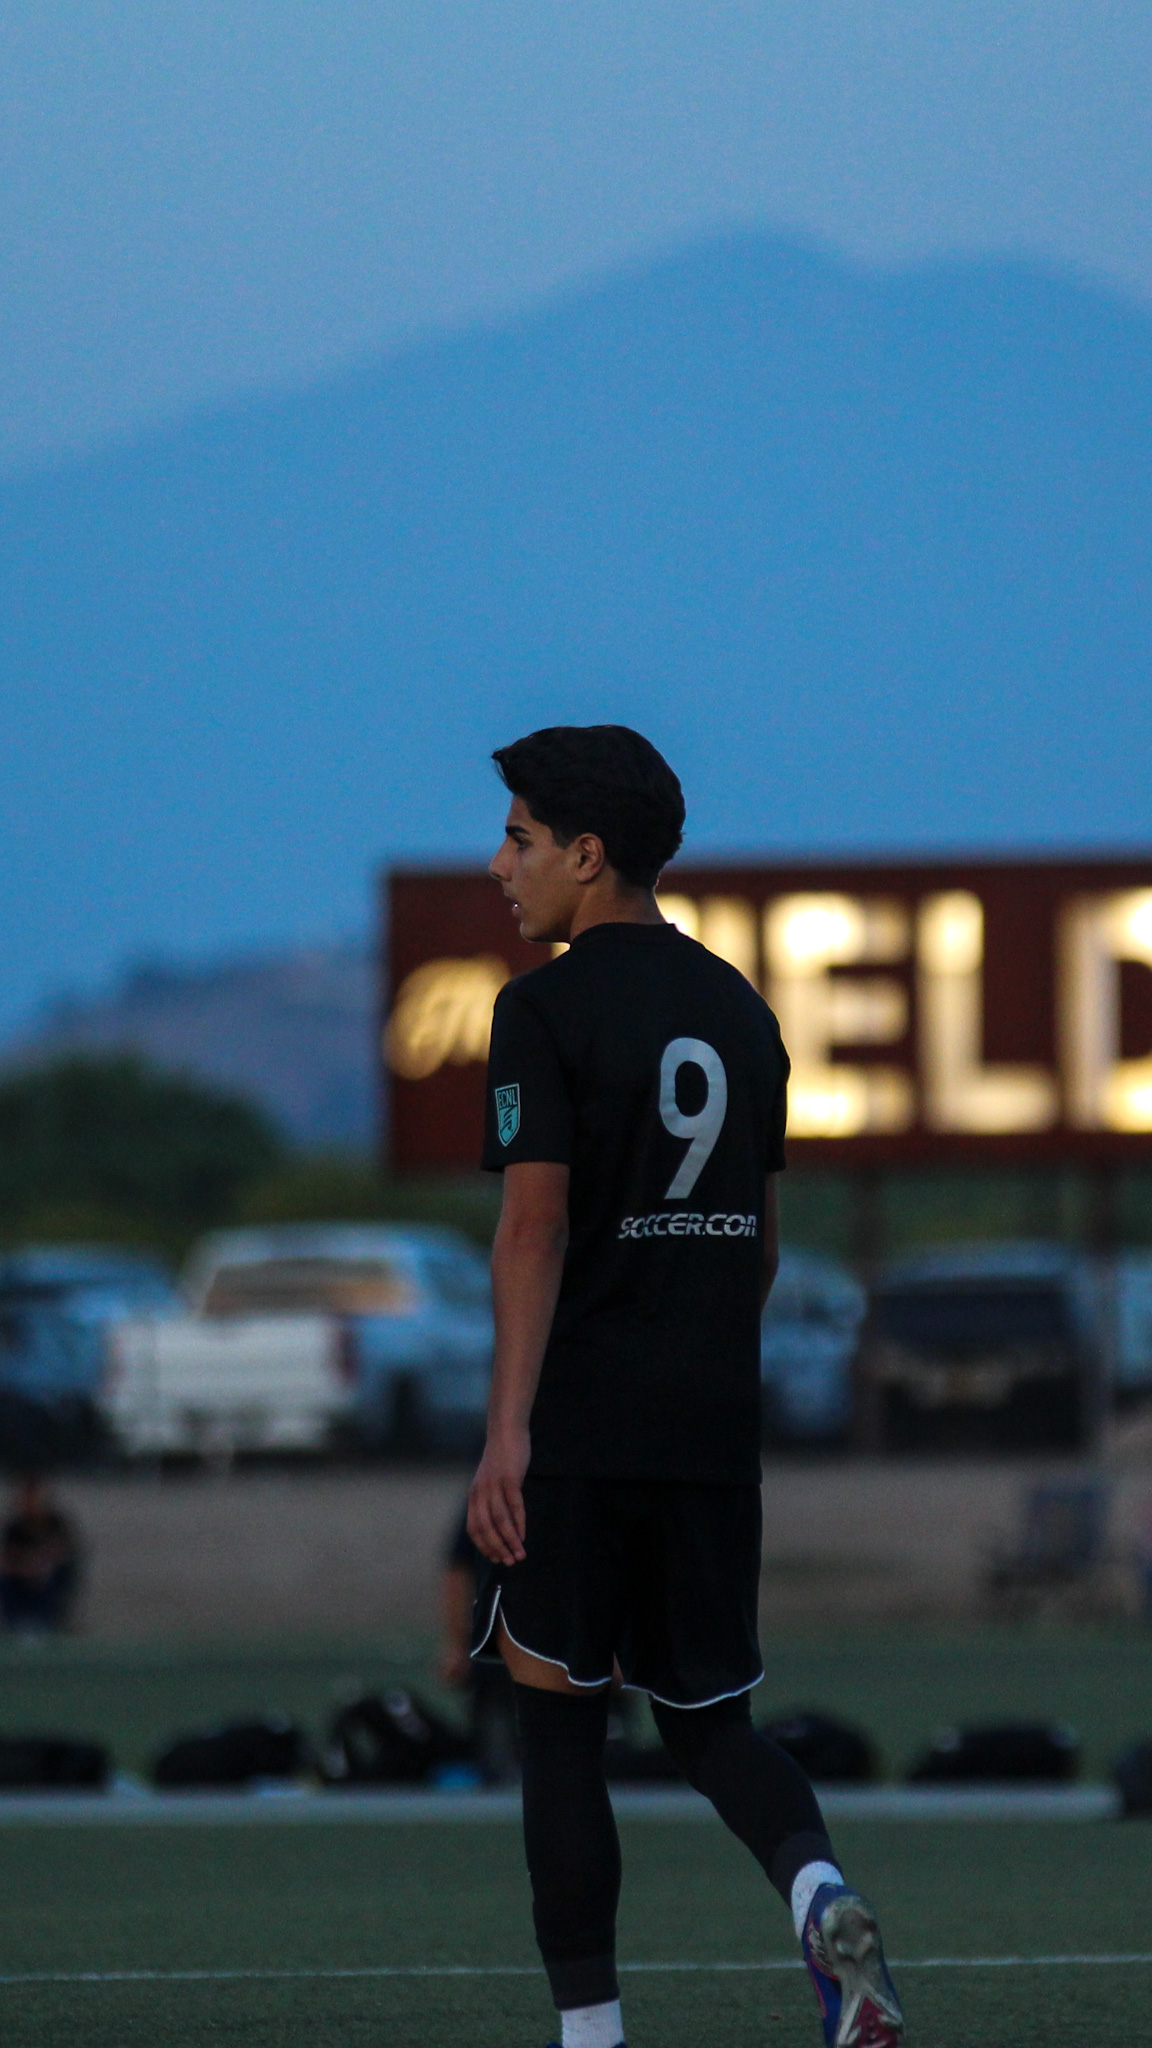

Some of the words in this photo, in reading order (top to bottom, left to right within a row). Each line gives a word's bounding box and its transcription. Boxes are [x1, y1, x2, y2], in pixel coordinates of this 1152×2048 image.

[550, 887, 1152, 1134] ELD
[497, 1088, 518, 1109] ECNL
[659, 1036, 728, 1200] 9
